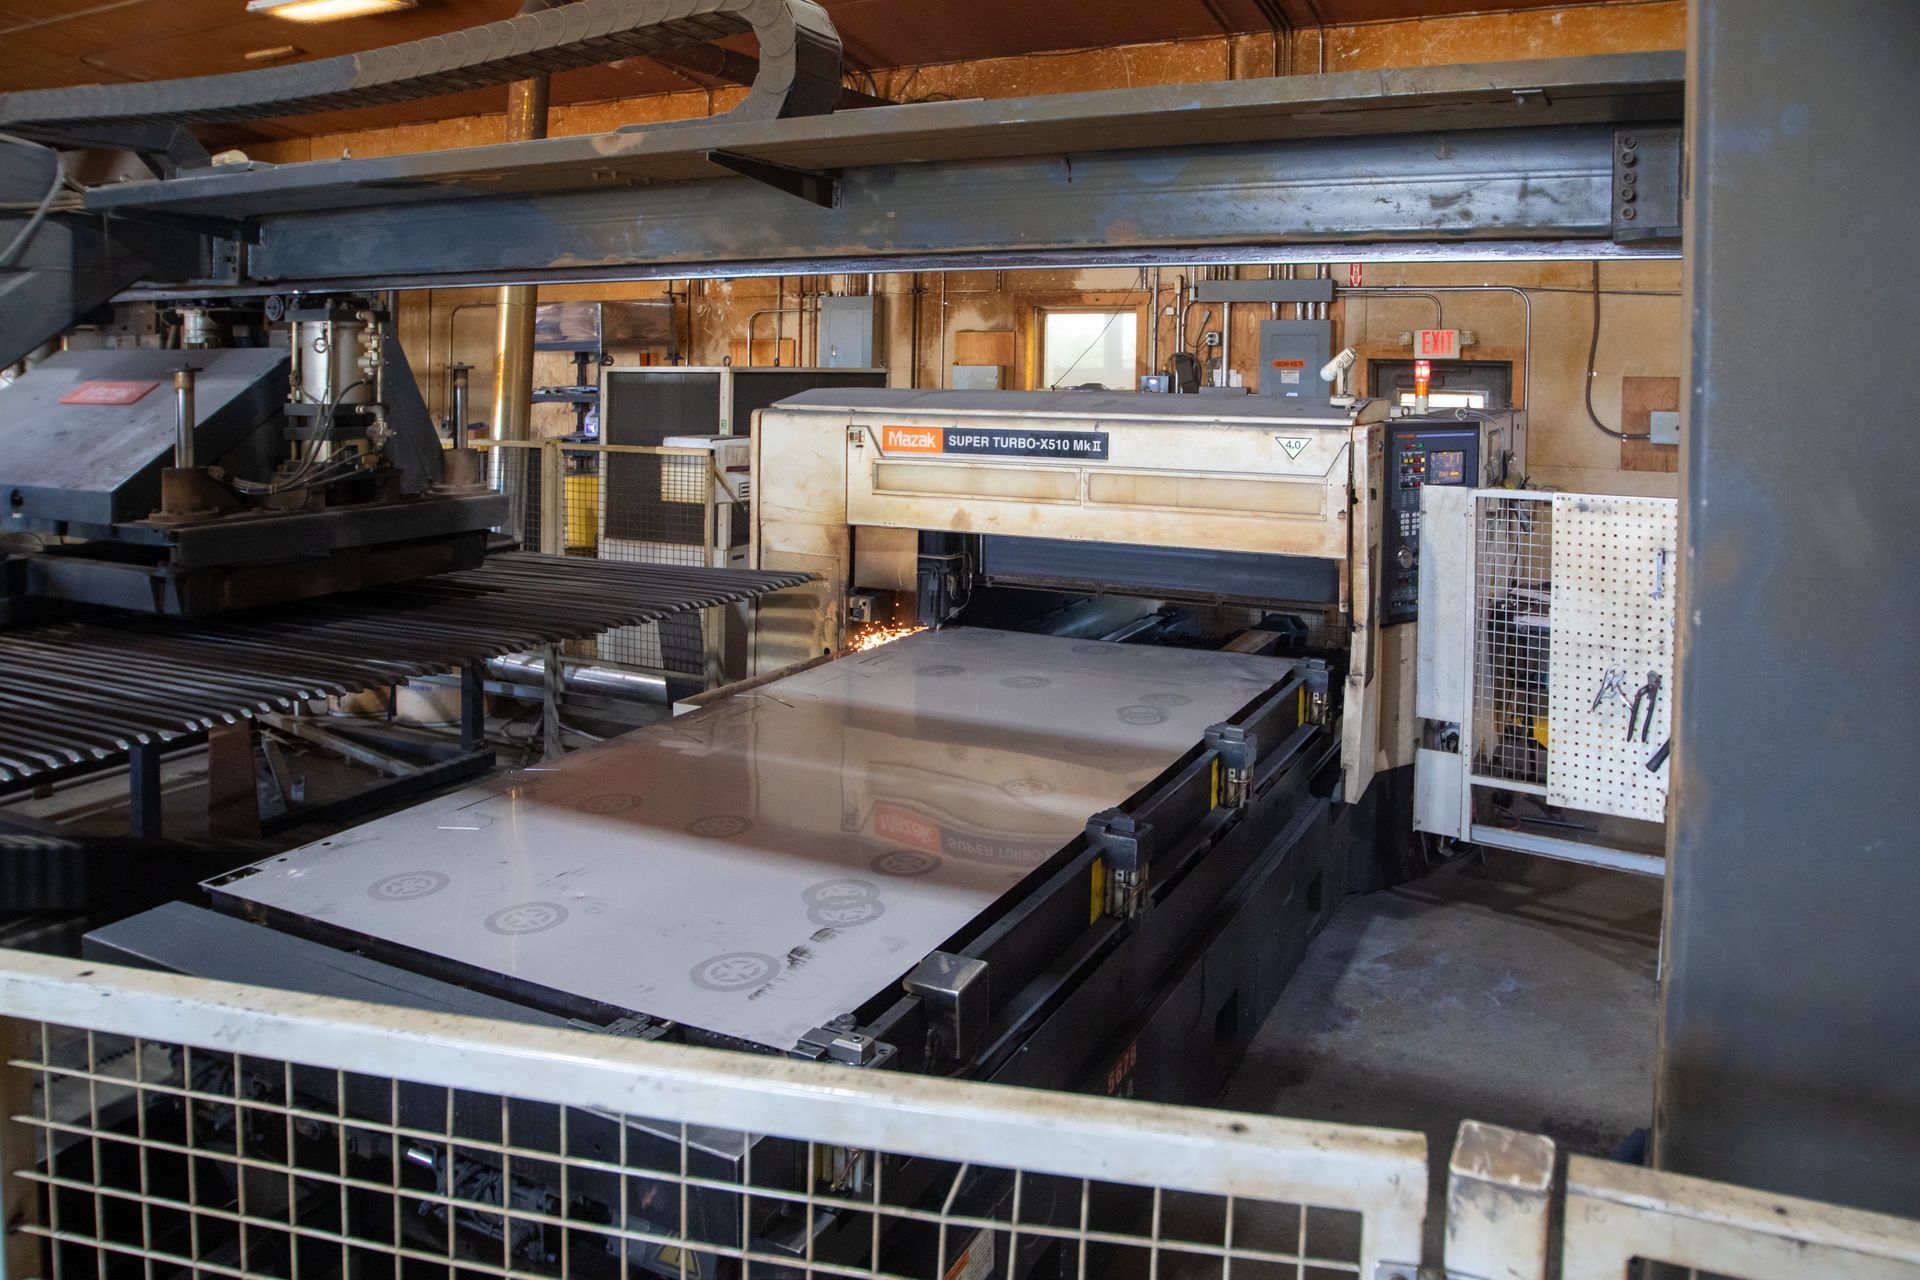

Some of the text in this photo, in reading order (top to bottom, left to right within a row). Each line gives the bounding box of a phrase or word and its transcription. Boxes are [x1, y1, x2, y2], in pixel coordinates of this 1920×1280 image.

[1422, 331, 1453, 355] EXIT
[888, 430, 936, 448] Mazak
[948, 435, 989, 448] SUPER
[993, 436, 1070, 451] TURBO-X510
[1285, 440, 1302, 449] 4.0
